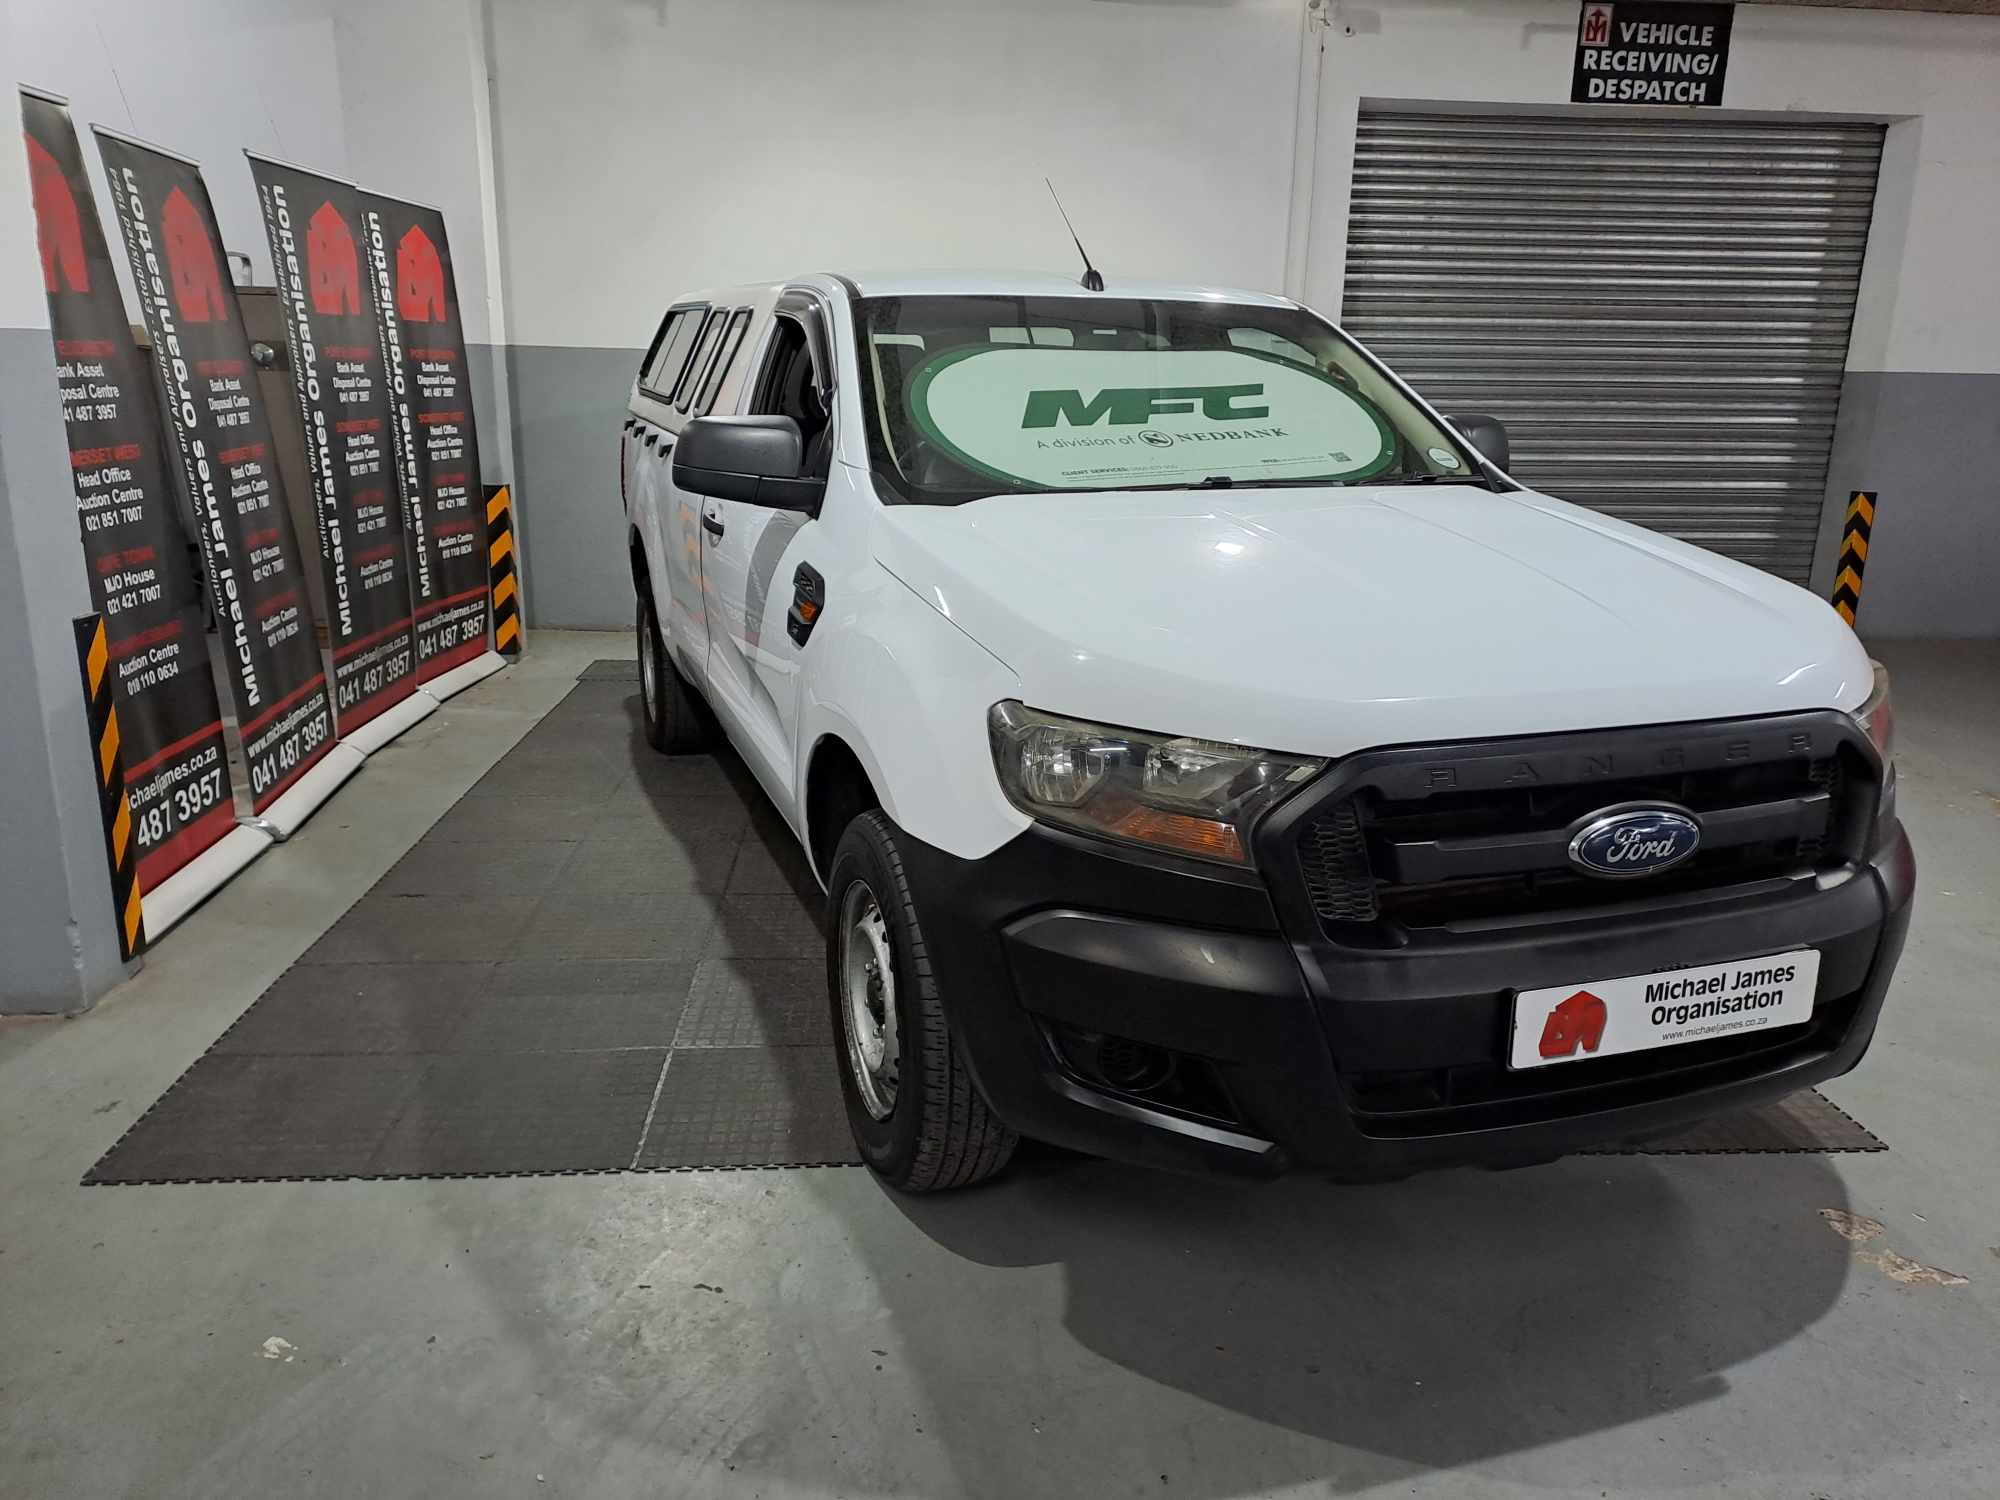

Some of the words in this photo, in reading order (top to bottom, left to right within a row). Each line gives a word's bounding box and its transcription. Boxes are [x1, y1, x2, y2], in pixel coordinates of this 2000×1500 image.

[1619, 22, 1715, 47] VEHICLE
[1582, 49, 1719, 76] RECEIVING/
[1588, 77, 1708, 103] DESPATCH
[120, 213, 153, 314] Established
[122, 167, 198, 428] Organisation
[273, 185, 320, 401] Organisation
[368, 211, 405, 395] Organisation
[57, 364, 76, 378] ank
[77, 362, 105, 378] Asset
[153, 328, 179, 415] Appraisers
[60, 384, 87, 403] posal
[88, 383, 120, 400] Centre
[63, 406, 75, 422] 41
[75, 405, 93, 421] 487
[95, 404, 118, 420] 3957
[299, 394, 310, 421] and
[1021, 383, 1270, 429] MFC
[174, 421, 189, 453] and
[305, 424, 318, 473] Valuers
[399, 403, 418, 488] James
[1036, 439, 1050, 449] A
[1051, 436, 1117, 449] division
[1120, 434, 1137, 447] of
[1175, 427, 1288, 443] NEDBANK
[77, 470, 102, 489] Head
[101, 467, 132, 484] Office
[313, 410, 336, 510] James
[76, 493, 111, 512] Auction
[111, 487, 144, 504] Centre
[184, 457, 202, 516] Valuers
[193, 440, 230, 558] James
[85, 514, 102, 532] 021
[101, 510, 120, 528] 851
[120, 505, 143, 523] 7007
[410, 496, 431, 597] Michael
[104, 574, 123, 594] MJO
[123, 569, 156, 588] House
[202, 522, 226, 616] Auctioneers,
[327, 518, 352, 636] Michael
[106, 597, 121, 616] 021
[121, 590, 139, 609] 421
[139, 584, 161, 604] 7007
[220, 568, 261, 707] Michael
[419, 632, 438, 660] 041
[440, 623, 458, 649] 487
[461, 613, 485, 641] 3957
[118, 655, 149, 678] Auction
[149, 643, 180, 663] Centre
[156, 661, 179, 683] 0634
[339, 676, 360, 709] 041
[363, 664, 383, 693] 487
[385, 649, 410, 682] 3957
[252, 753, 277, 794] 041
[279, 732, 300, 770] 487
[302, 710, 328, 752] 3957
[1423, 732, 1812, 789] RANGER
[129, 746, 217, 809] chaeljames.co.za
[137, 799, 172, 847] 487
[174, 767, 221, 821] 3957
[1605, 822, 1678, 865] Ford
[1645, 972, 1727, 1004] Michael
[1730, 965, 1796, 991] James
[1651, 989, 1783, 1026] Organisation
[1662, 1017, 1768, 1041] www.michaeljames.co.za
